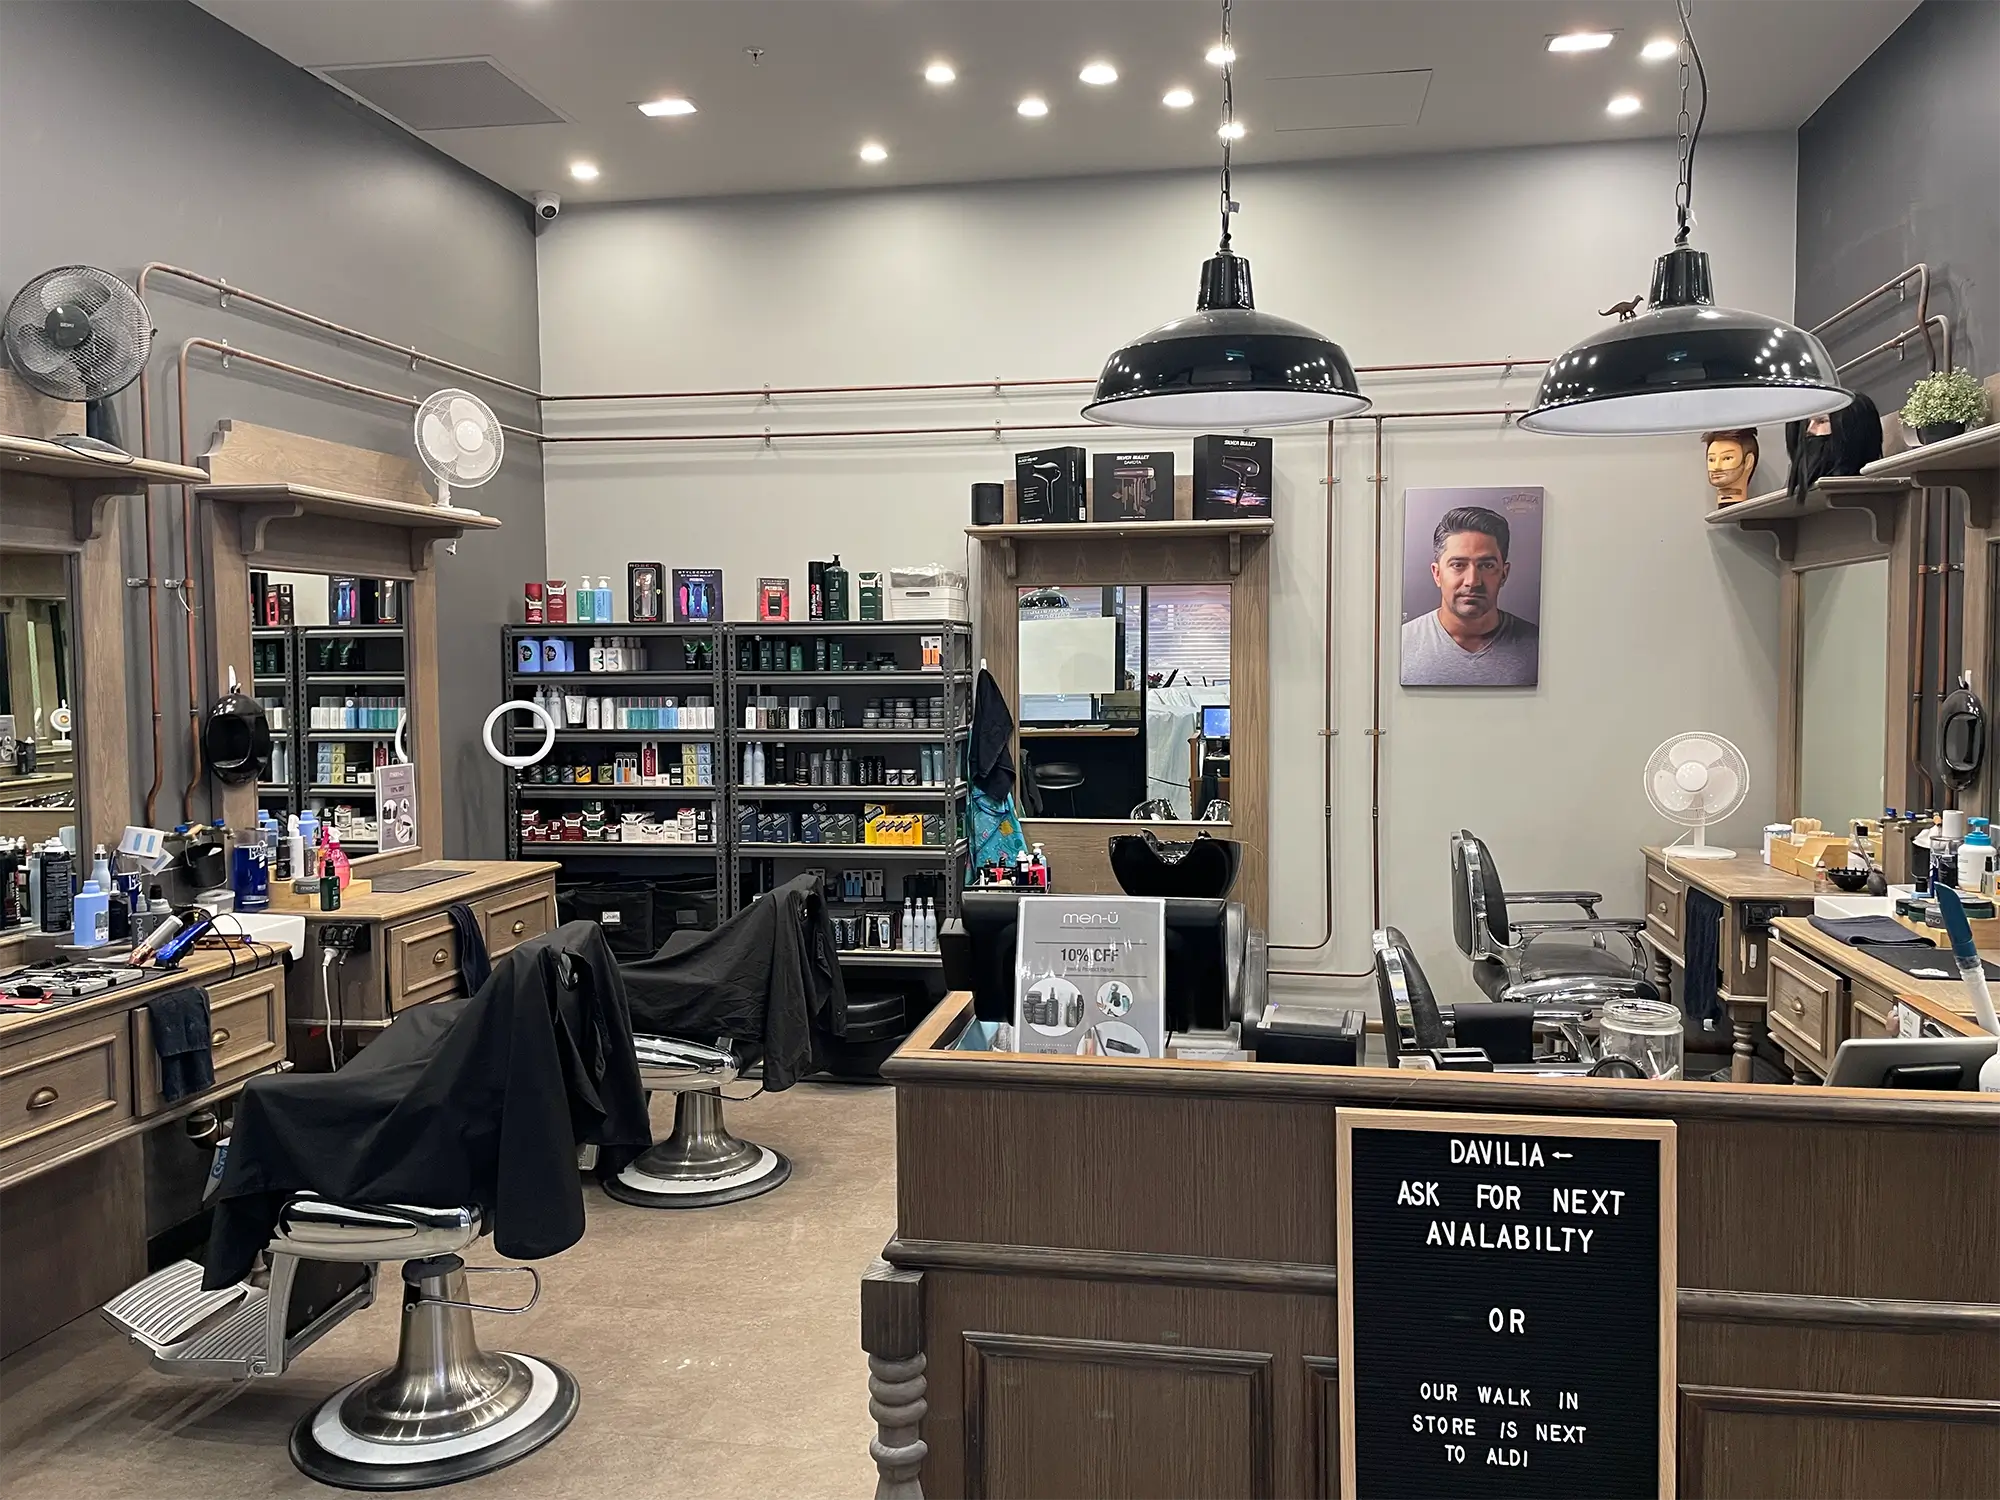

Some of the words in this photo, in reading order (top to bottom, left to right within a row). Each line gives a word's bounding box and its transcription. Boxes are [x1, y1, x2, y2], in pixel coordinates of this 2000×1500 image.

[1063, 911, 1119, 924] men-ü
[1061, 948, 1089, 961] 10%
[1450, 1139, 1545, 1168] DAVILIA
[1397, 1180, 1440, 1207] ASK
[1476, 1184, 1522, 1211] FOR
[1553, 1188, 1626, 1216] NEXT
[1425, 1220, 1594, 1254] AVALABILTY
[1488, 1307, 1526, 1334] OR
[1420, 1382, 1458, 1402] OUR
[1477, 1385, 1532, 1407] WALK
[1558, 1391, 1579, 1410] IN
[1412, 1414, 1477, 1436] STORE
[1499, 1421, 1518, 1439] IS
[1535, 1423, 1587, 1444] NEXT
[1444, 1444, 1466, 1464] TO
[1486, 1447, 1529, 1468] ALDI
